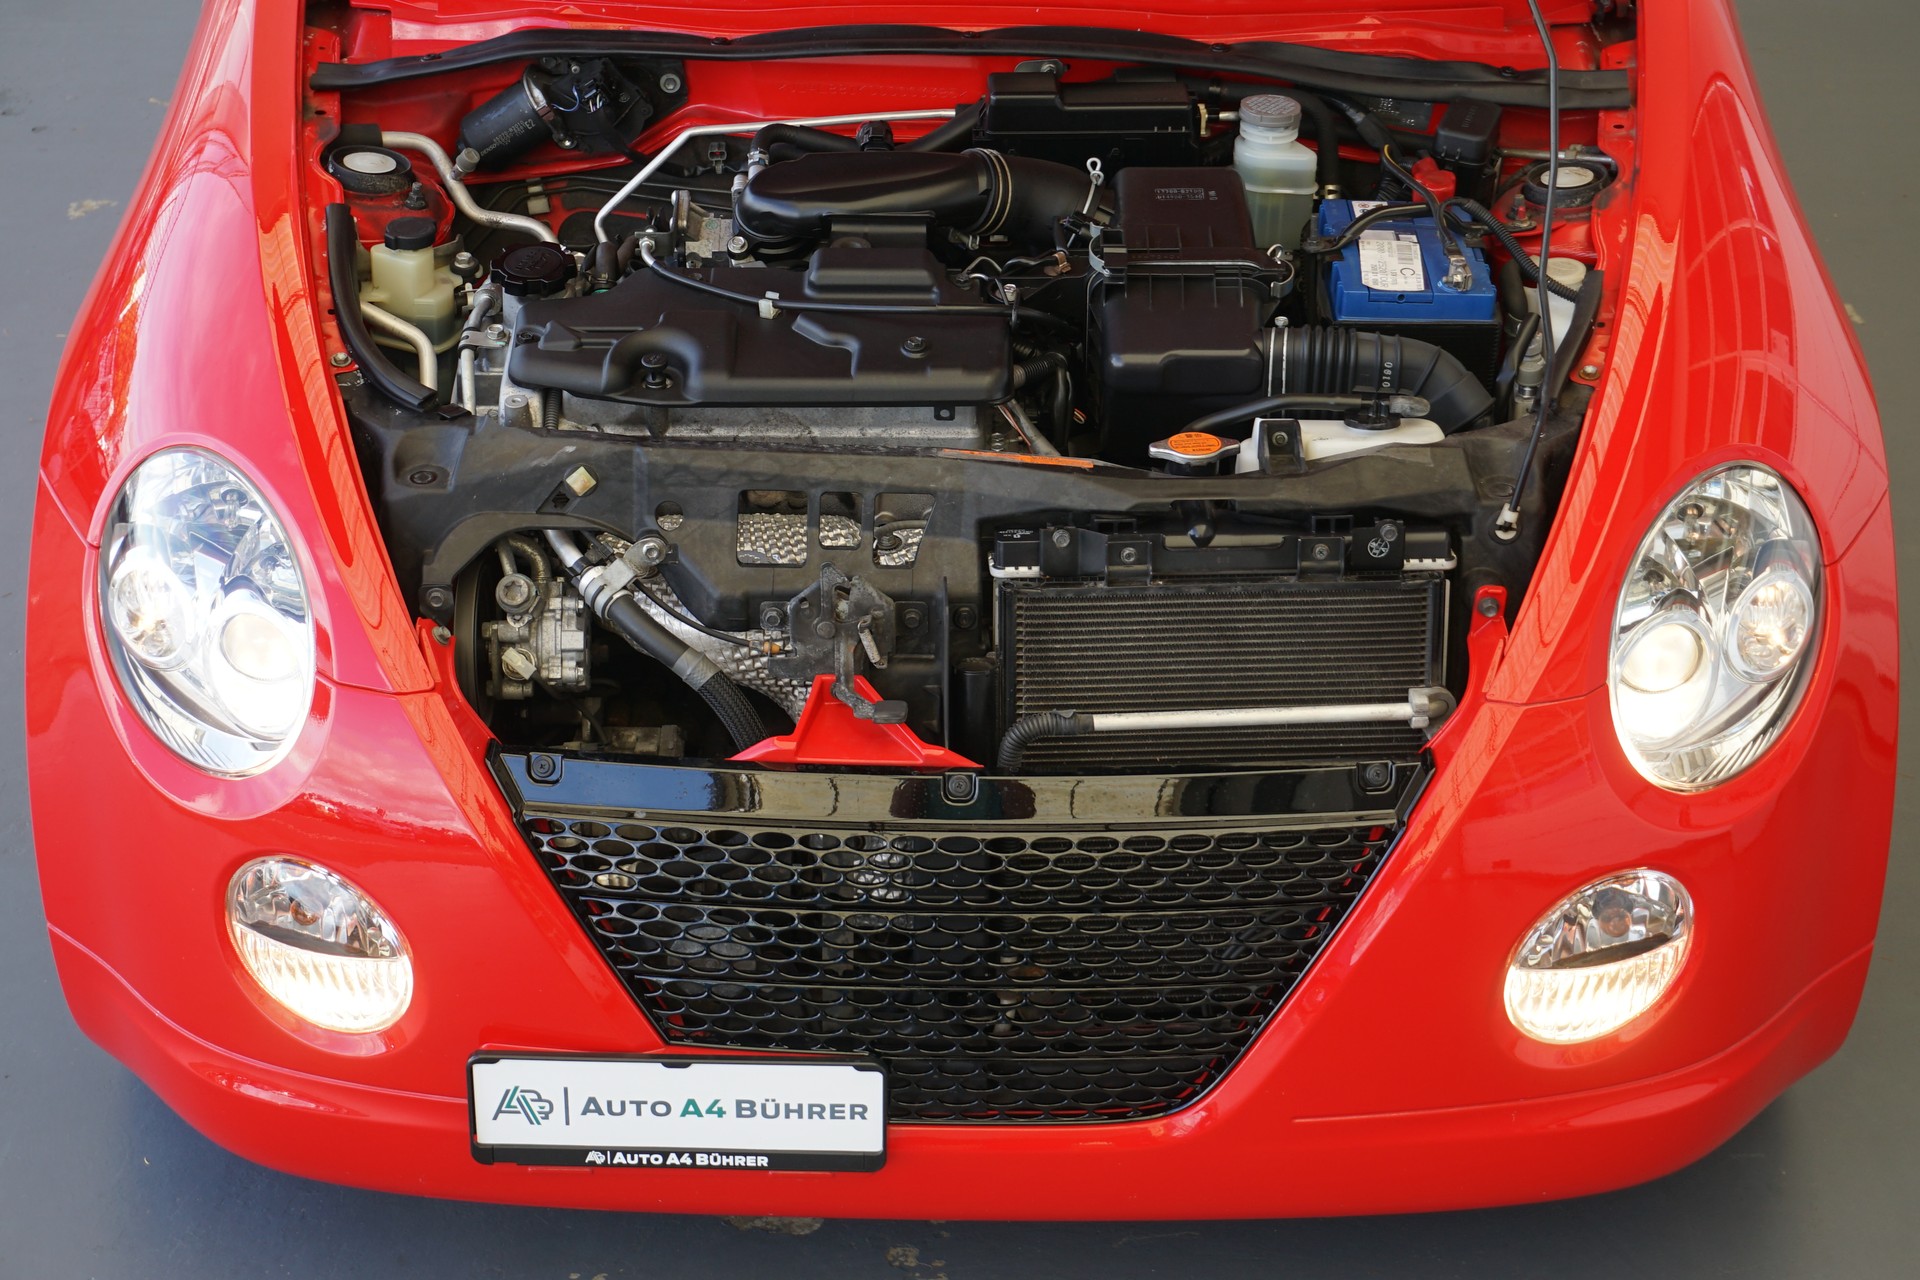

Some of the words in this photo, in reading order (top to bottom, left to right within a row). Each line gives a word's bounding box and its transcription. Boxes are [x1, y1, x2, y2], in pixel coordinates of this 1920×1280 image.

[580, 1096, 672, 1117] AUTO
[679, 1098, 727, 1118] A4
[735, 1098, 869, 1120] BÜHRER
[612, 1151, 663, 1166] AUTO
[666, 1152, 692, 1166] A4
[695, 1152, 769, 1167] BÜHRER
